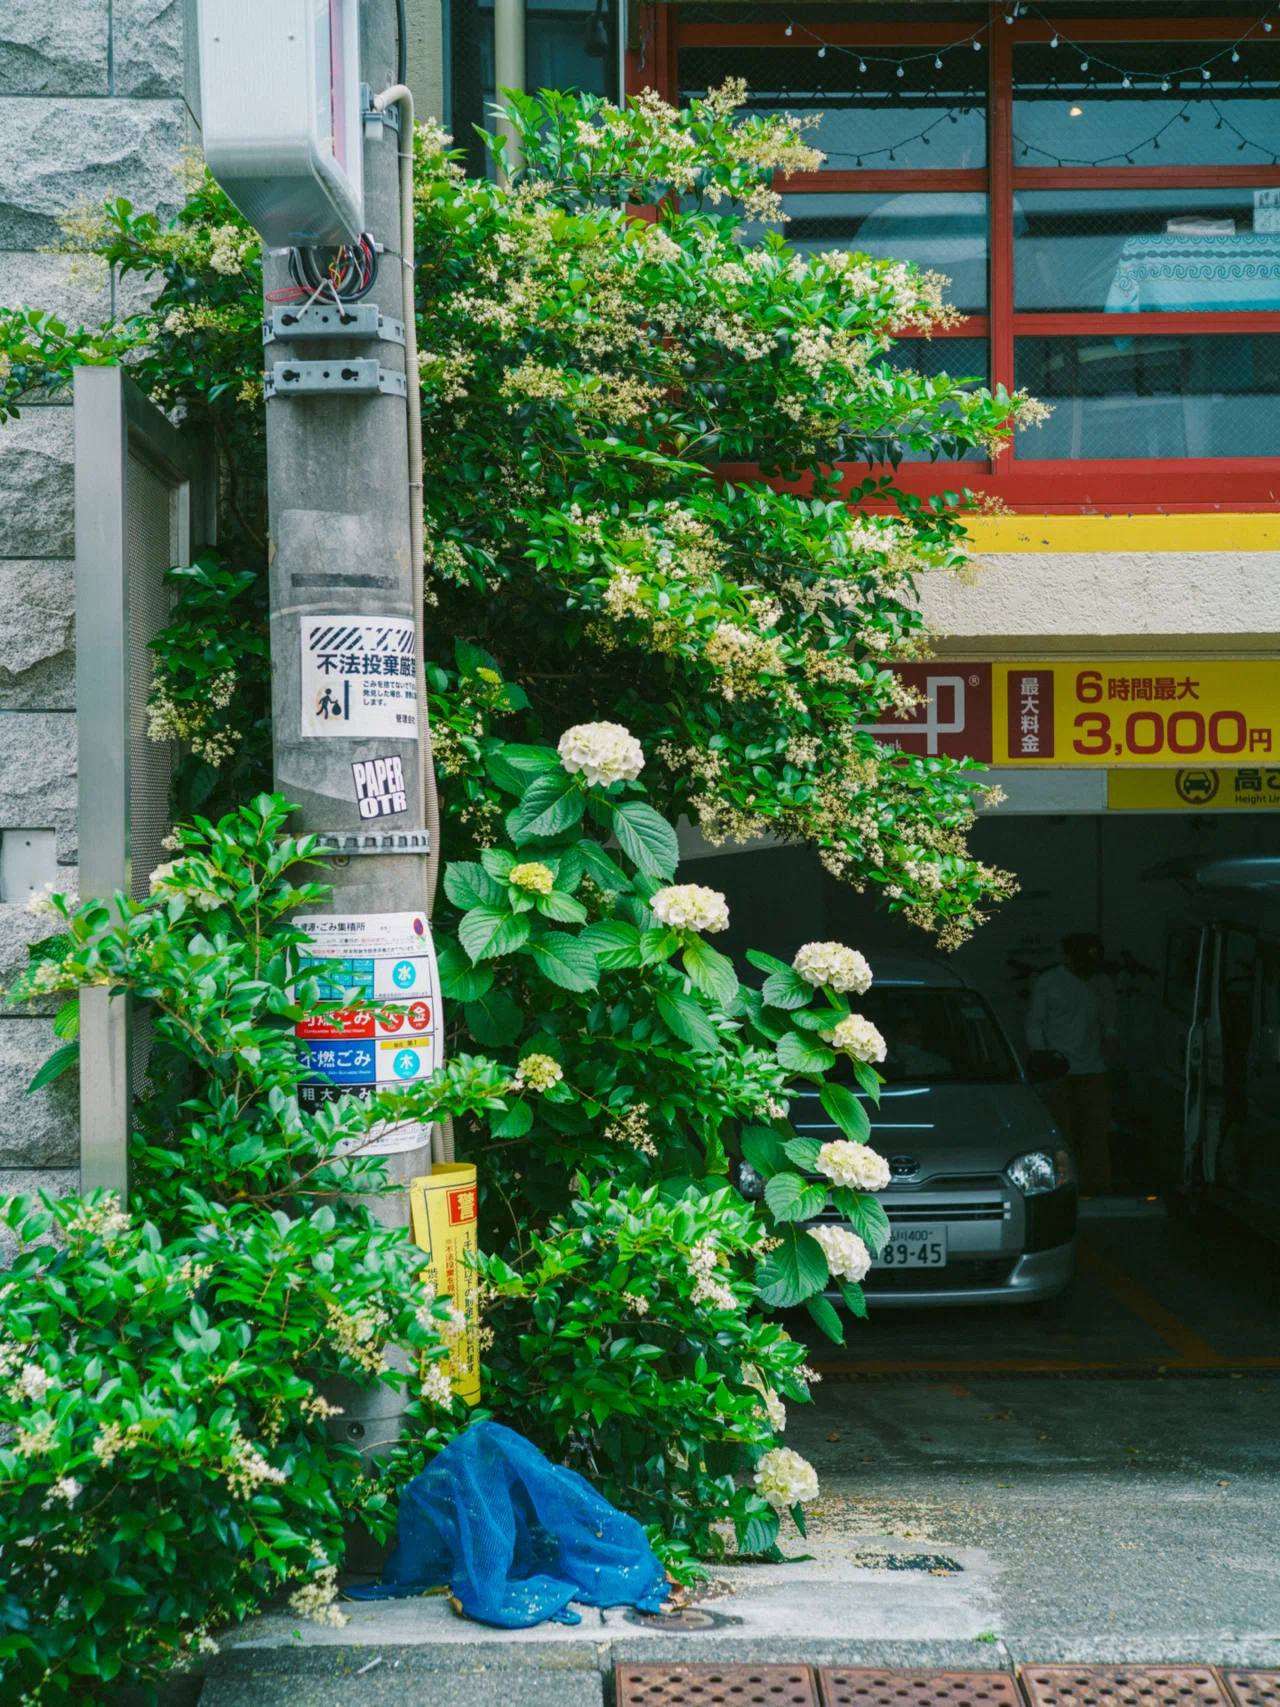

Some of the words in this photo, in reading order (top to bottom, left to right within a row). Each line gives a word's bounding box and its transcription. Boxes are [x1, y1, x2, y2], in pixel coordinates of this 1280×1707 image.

[1076, 671, 1200, 703] 6時間最大
[1021, 678, 1039, 752] 最大料金
[1073, 711, 1272, 755] 3,000円
[352, 756, 405, 800] PAPER
[359, 792, 407, 819] OTR
[1235, 794, 1266, 805] Height
[398, 964, 411, 981] 水
[413, 1006, 426, 1022] 金
[300, 1050, 371, 1069] 不燃ごみ
[400, 1054, 413, 1071] 木
[883, 1244, 942, 1265] 89-45
